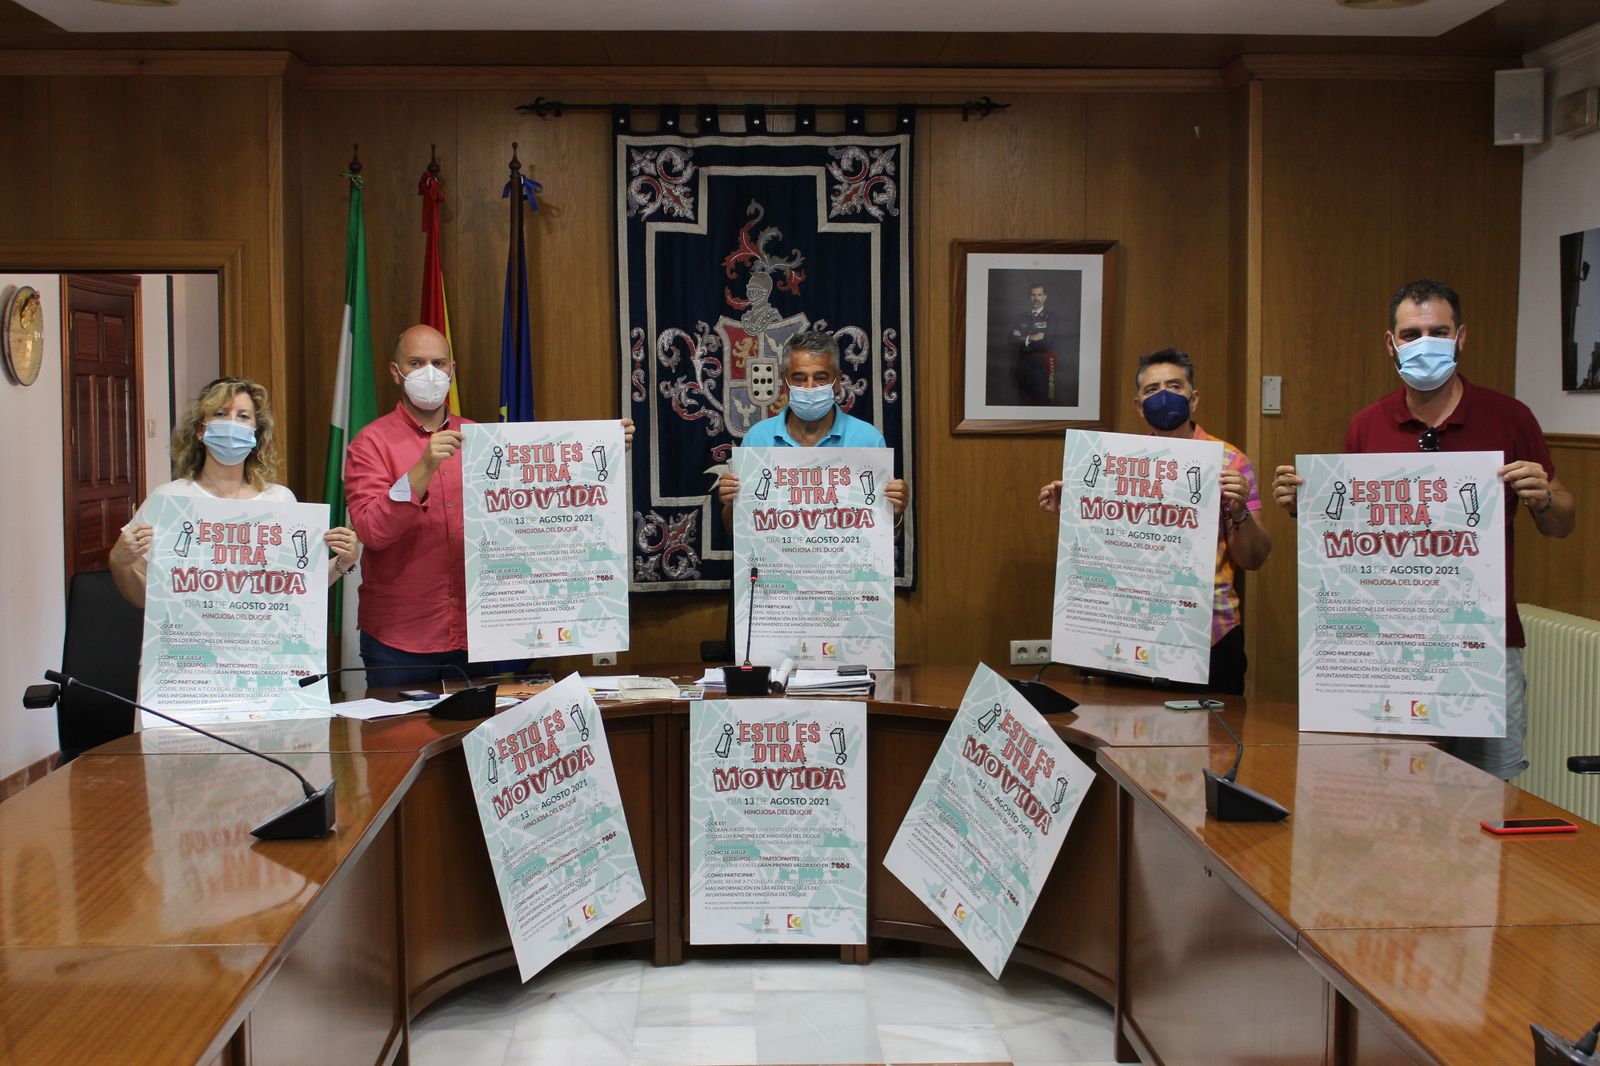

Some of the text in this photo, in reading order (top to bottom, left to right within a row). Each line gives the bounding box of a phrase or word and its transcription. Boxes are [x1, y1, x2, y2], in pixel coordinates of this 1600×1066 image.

[507, 442, 583, 464] ESTO ES
[522, 463, 570, 483] OTRA
[776, 466, 850, 486] ESTO ES
[1104, 455, 1178, 480] ESTO ES
[484, 483, 608, 512] MOVIDA
[790, 486, 837, 505] OTRA
[1116, 476, 1163, 499] OTRA
[1352, 478, 1447, 503] ESTO ES
[515, 517, 525, 525] 13
[526, 516, 536, 524] DE
[538, 514, 573, 523] AGOSTO
[574, 513, 593, 521] 2021
[753, 507, 875, 531] MOVIDA
[1079, 495, 1199, 530] MOVIDA
[1370, 503, 1430, 526] OTRA
[198, 522, 282, 545] ESTO ES
[1104, 539, 1133, 547] HINOJOSA
[1144, 543, 1165, 551] DUQUE
[1105, 528, 1115, 536] 13
[1116, 529, 1126, 537] DE
[1128, 530, 1161, 541] AGOSTO
[1162, 534, 1181, 543] 2021
[1323, 529, 1479, 558] MOVIDA
[213, 544, 266, 566] OTRA
[170, 567, 307, 596] MOVIDA
[1360, 565, 1372, 574] 13
[1374, 565, 1386, 574] DE
[1389, 565, 1433, 574] AGOSTO
[1435, 565, 1459, 574] 2021
[202, 600, 213, 608] 13
[215, 600, 226, 608] DE
[229, 601, 266, 610] AGOSTO
[268, 602, 289, 610] 2021
[496, 709, 565, 760] ESTO ES
[738, 723, 820, 743] ESTO ES
[515, 737, 559, 774] OTRA
[754, 744, 805, 763] OTRA
[1000, 712, 1055, 779] ESTO ES
[1002, 739, 1039, 786] OTRA
[492, 745, 595, 820] MOVIDA
[713, 766, 846, 791] MOVIDA
[964, 736, 1053, 836] MOVIDA
[520, 810, 530, 821] 13
[529, 804, 540, 816] DE
[540, 786, 570, 810] AGOSTO
[570, 777, 587, 793] 2021
[744, 797, 754, 805] 13
[756, 797, 767, 805] DE
[770, 797, 807, 805] AGOSTO
[809, 797, 829, 805] 2021
[978, 779, 987, 789] 13
[986, 787, 996, 798] DE
[995, 796, 1019, 823] AGOSTO
[1018, 820, 1032, 838] 2021
[522, 795, 577, 831] HINOJOSA DEL DUQUE
[973, 788, 1018, 836] HINOJOSA DEL DUQUE
